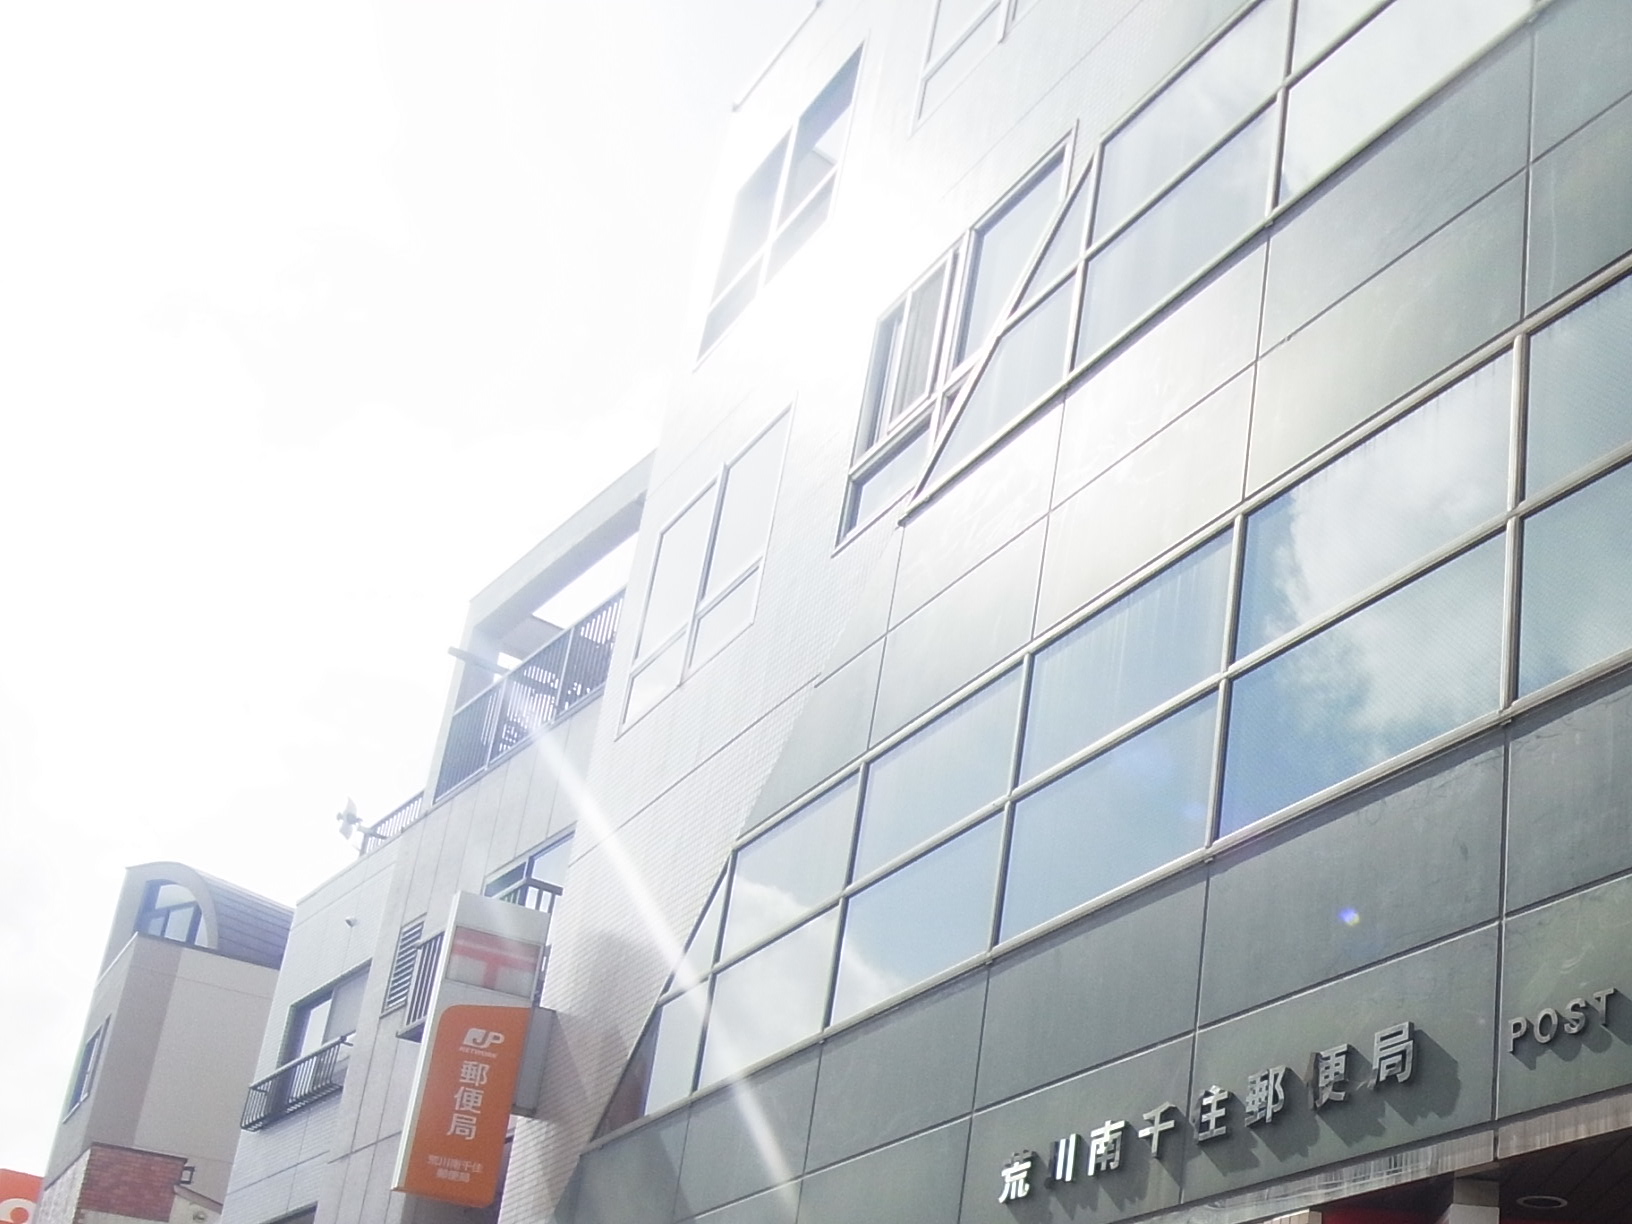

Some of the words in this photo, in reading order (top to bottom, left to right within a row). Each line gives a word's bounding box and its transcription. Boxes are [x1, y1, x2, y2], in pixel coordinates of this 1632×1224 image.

[463, 1028, 505, 1049] JP
[1508, 987, 1616, 1053] POST
[446, 1060, 490, 1140] 郵便局
[999, 1021, 1415, 1204] 荒川南千住郵便局
[427, 1154, 483, 1173] 荒川南千住
[436, 1168, 470, 1184] 郵便局
